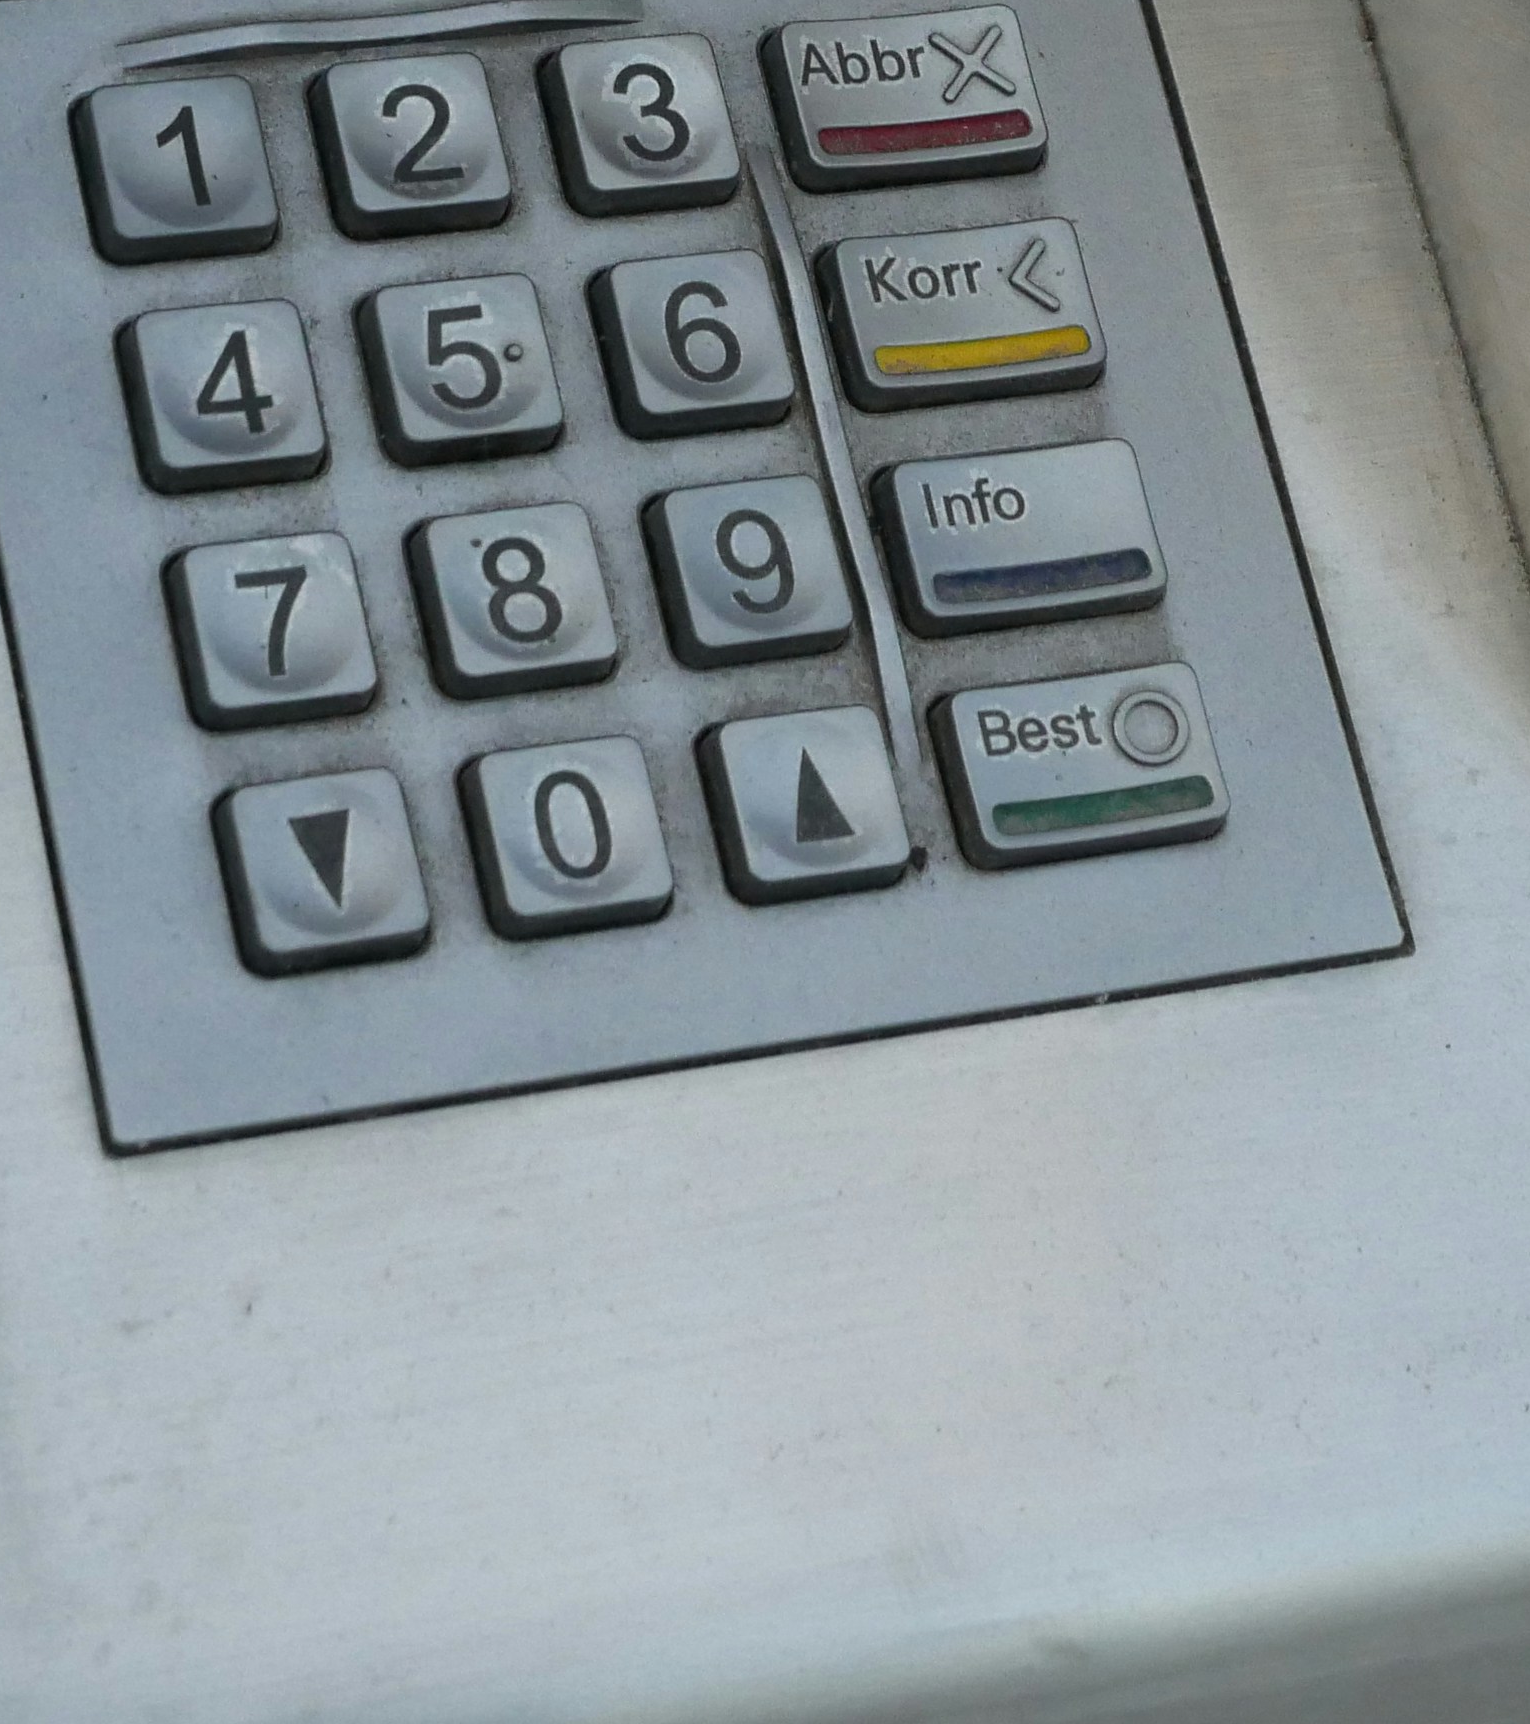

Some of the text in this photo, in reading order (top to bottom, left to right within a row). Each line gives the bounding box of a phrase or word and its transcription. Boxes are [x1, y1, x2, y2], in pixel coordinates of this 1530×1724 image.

[801, 39, 925, 86] Abbr
[156, 63, 690, 206] 1 2 3
[864, 257, 981, 303] Korr
[196, 281, 741, 434] 4 5 6
[921, 478, 1026, 528] Info
[234, 509, 794, 675] 7 8 9
[978, 704, 1102, 756] Best
[534, 770, 612, 878] 0
